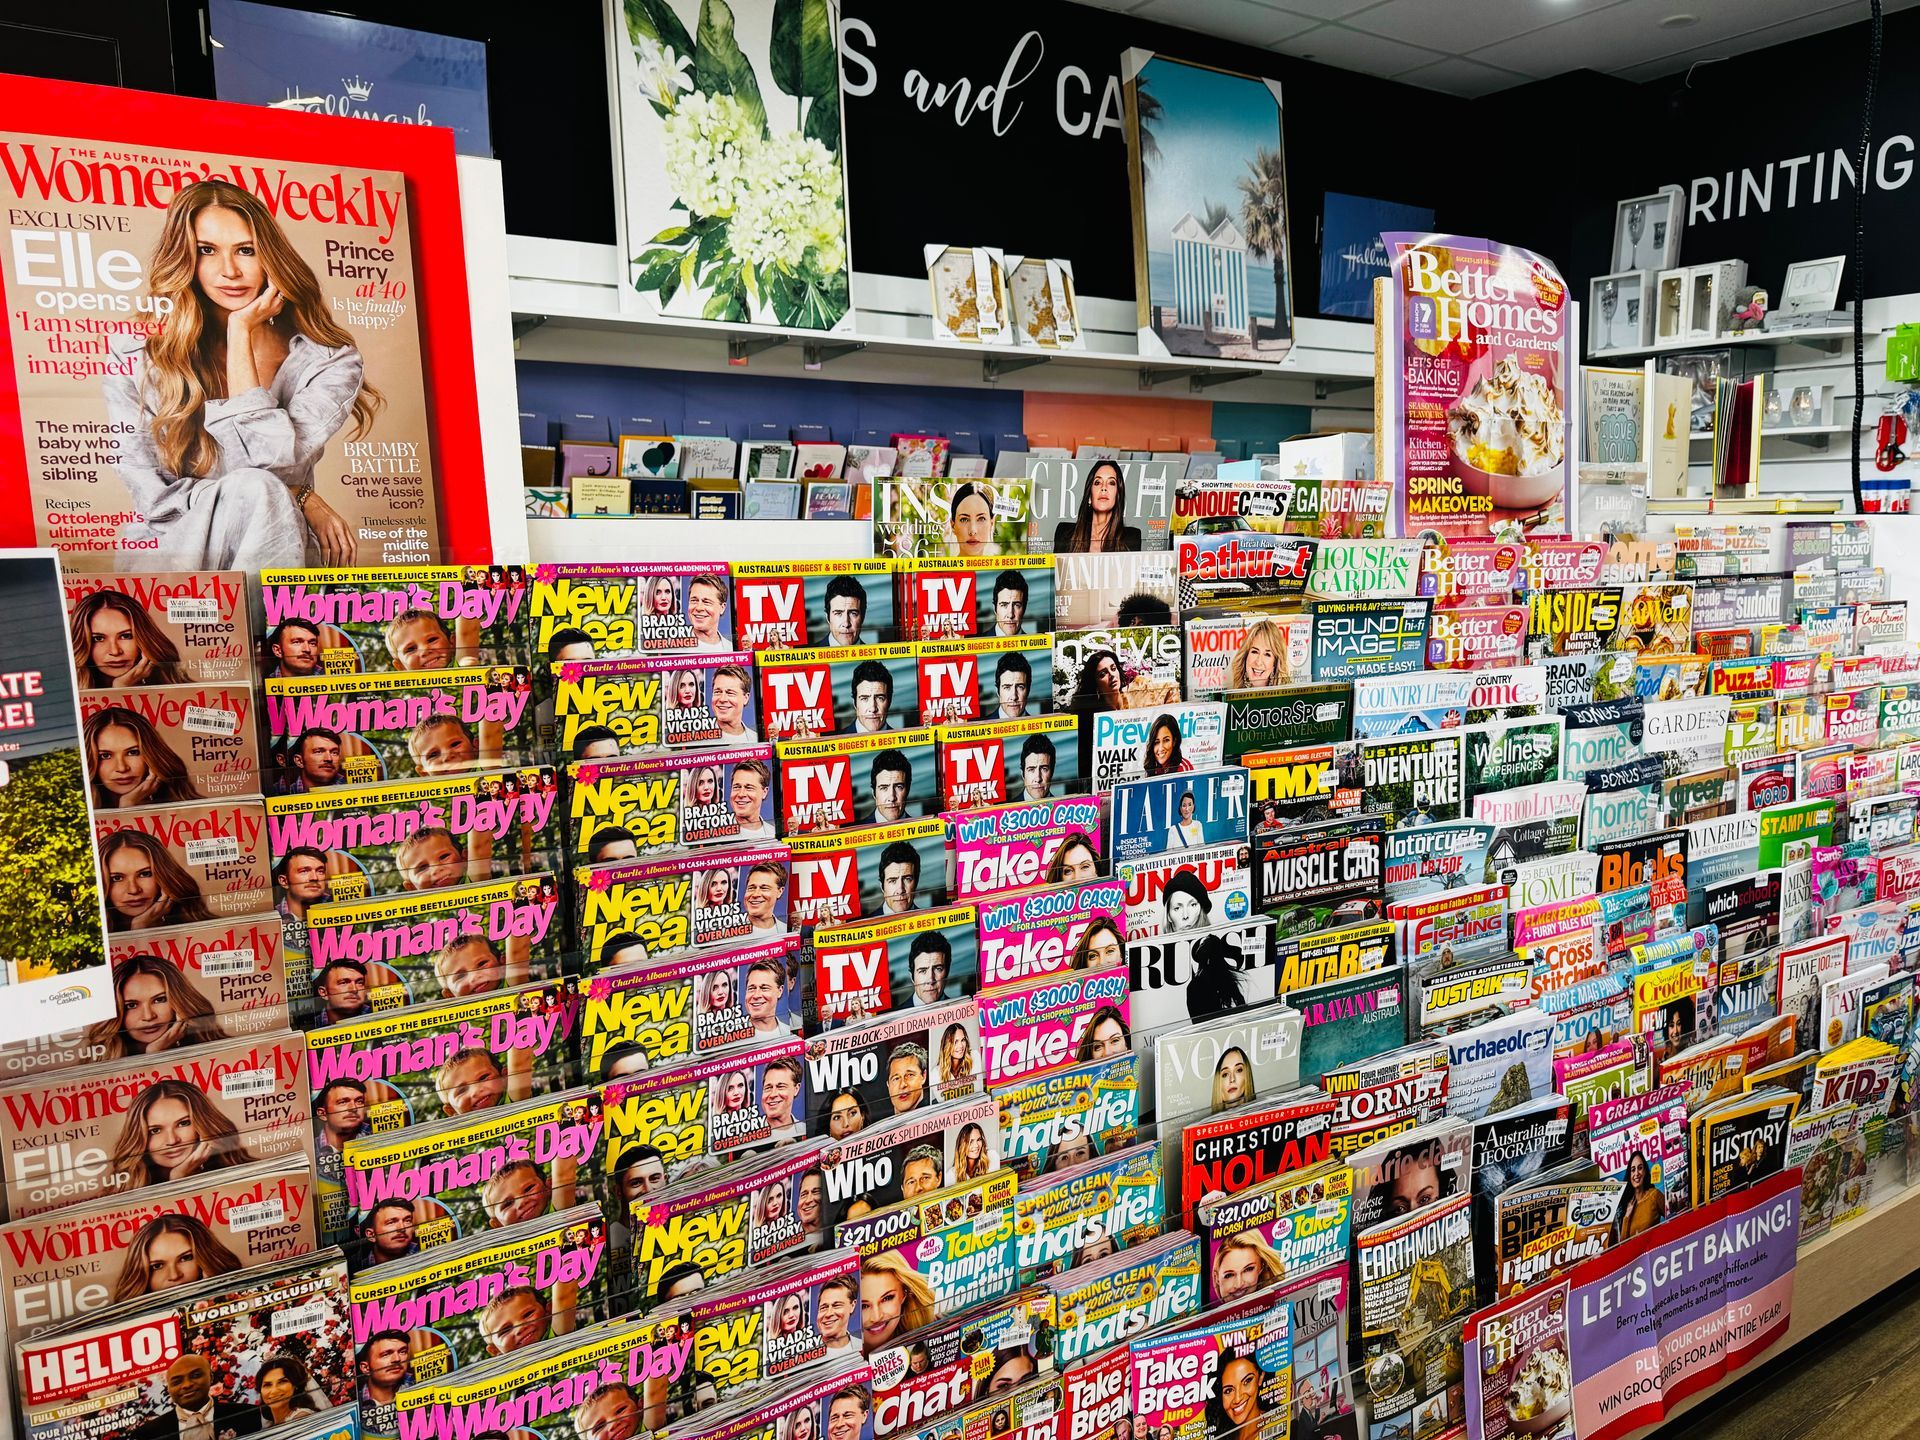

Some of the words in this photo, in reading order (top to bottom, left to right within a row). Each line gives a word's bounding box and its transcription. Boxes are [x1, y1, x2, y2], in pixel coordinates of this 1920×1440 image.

[903, 31, 1044, 137] and
[69, 148, 96, 158] THE
[104, 152, 191, 168] AUSTRALIAN
[1658, 134, 1915, 227] RINTING
[227, 163, 402, 245] Weekly
[8, 209, 131, 234] EXCLUSIVE
[11, 229, 143, 290] Elle
[325, 239, 394, 262] Prince
[327, 260, 387, 284] Harry
[1409, 250, 1518, 300] Better
[356, 282, 376, 299] at
[379, 280, 406, 299] 40
[36, 290, 130, 315] opens
[136, 295, 173, 319] up
[1437, 297, 1558, 343] Homes
[1476, 333, 1501, 345] and
[1505, 333, 1558, 351] Gardens
[1433, 358, 1451, 369] GET
[1408, 369, 1460, 386] BAKING!
[36, 420, 68, 435] The
[72, 421, 135, 436] miracle
[1602, 421, 1606, 438] I
[1608, 421, 1632, 440] LOVE
[40, 452, 90, 465] saved
[94, 452, 123, 465] her
[343, 441, 418, 458] BRUMBY
[1604, 442, 1630, 462] YOU!
[42, 467, 97, 483] sibling
[350, 458, 420, 473] BATTLE
[1409, 477, 1462, 495] SPRING
[45, 498, 90, 511] Recipes
[1409, 495, 1493, 513] MAKEOVERS
[1355, 513, 1384, 522] AUSTRALIA
[49, 525, 115, 539] ultimate
[51, 538, 118, 552] comfort
[121, 537, 158, 550] food
[1831, 545, 1870, 556] SUDOKU
[557, 565, 587, 574] Charlie
[792, 563, 823, 573] BIGGEST
[825, 563, 830, 572] &
[832, 562, 851, 572] BEST
[853, 562, 863, 571] TV
[864, 561, 886, 571] GUIDE
[267, 575, 305, 583] CURSED
[309, 574, 334, 582] LIVES
[1310, 568, 1408, 593] GARDEN
[439, 582, 507, 628] Day
[530, 579, 635, 617] New
[743, 584, 799, 621] TV
[1736, 590, 1780, 619] sudoku
[744, 622, 799, 643] WEEK
[1318, 616, 1398, 636] SOUND
[1872, 623, 1904, 634] PUZZLES
[1318, 635, 1396, 656] IMAGE
[1810, 633, 1840, 646] JUMBO
[1320, 666, 1354, 677] MUSIC
[1357, 663, 1386, 675] MADE
[1388, 661, 1416, 672] EASY!
[1476, 674, 1512, 686] COUNTRY
[1574, 706, 1621, 723] BONUS
[1830, 720, 1877, 740] PROBLEMS
[1098, 751, 1137, 765] WALK
[1566, 738, 1626, 764] home
[1098, 763, 1123, 778] OFF
[1483, 760, 1544, 776] EXPERIENCES
[1001, 807, 1050, 832] $3000
[1054, 805, 1097, 824] CASH
[1761, 812, 1804, 836] STAMP
[993, 836, 1006, 844] FOR
[1012, 830, 1044, 842] SHOPPING
[1045, 827, 1065, 836] SPREE!
[958, 845, 1039, 894] Take
[1263, 850, 1338, 896] MUSCLE
[1415, 916, 1502, 955] FISHING
[1545, 942, 1592, 969] Cross
[1431, 973, 1447, 985] FREE
[1448, 969, 1477, 980] PRIVATE
[1479, 961, 1525, 975] ADVERTISING
[49, 990, 75, 1001] Golden
[57, 995, 81, 1005] Casket
[1427, 982, 1470, 1010] JUST
[830, 1039, 849, 1051] THE
[851, 1029, 882, 1048] BLOCK:
[884, 1024, 904, 1039] SPLIT
[906, 1016, 936, 1034] DRAMA
[937, 1005, 975, 1027] EXPLODES
[1642, 1009, 1667, 1029] NEW!
[809, 1052, 878, 1094] Who
[1377, 1063, 1399, 1076] HORNBY
[1326, 1072, 1359, 1093] WIN
[1361, 1072, 1399, 1089] LOCOMOTIVES
[1397, 1096, 1441, 1119] magazine
[1196, 1120, 1235, 1135] SPECIAL
[1300, 1102, 1335, 1114] EDITION
[1712, 1120, 1782, 1166] HISTORY
[1196, 1131, 1331, 1198] NOLAN
[1217, 1196, 1269, 1224] $21,000
[1525, 1226, 1574, 1256] FACTORY
[1653, 1241, 1698, 1287] GET
[1704, 1200, 1792, 1264] BAKING!
[191, 1300, 248, 1324] WORLD
[254, 1277, 333, 1307] EXCLUSIVE
[1616, 1311, 1639, 1329] Berry
[1680, 1283, 1697, 1297] bars,
[1699, 1271, 1723, 1289] orange
[1750, 1251, 1768, 1267] cakes,
[304, 1303, 323, 1314] $8.99
[1664, 1330, 1693, 1354] YOUR
[1695, 1310, 1736, 1339] CHANCE
[1739, 1303, 1752, 1317] TO
[29, 1321, 179, 1393] HELLO!
[1135, 1351, 1150, 1360] Your
[1152, 1345, 1177, 1357] bumper
[1179, 1340, 1206, 1352] monthly
[1598, 1393, 1622, 1415] WIN
[1623, 1357, 1683, 1401] GROCERIES
[1685, 1344, 1706, 1365] FOR
[1709, 1337, 1723, 1355] AN
[1758, 1301, 1781, 1326] YEAR!
[1134, 1352, 1201, 1389] Take
[1202, 1350, 1218, 1372] a
[874, 1366, 970, 1434] chat
[1138, 1375, 1216, 1415] Break
[33, 1412, 54, 1423] FULL
[57, 1402, 100, 1419] WEDDING
[104, 1390, 136, 1406] ALBUM
[1161, 1406, 1192, 1424] June
